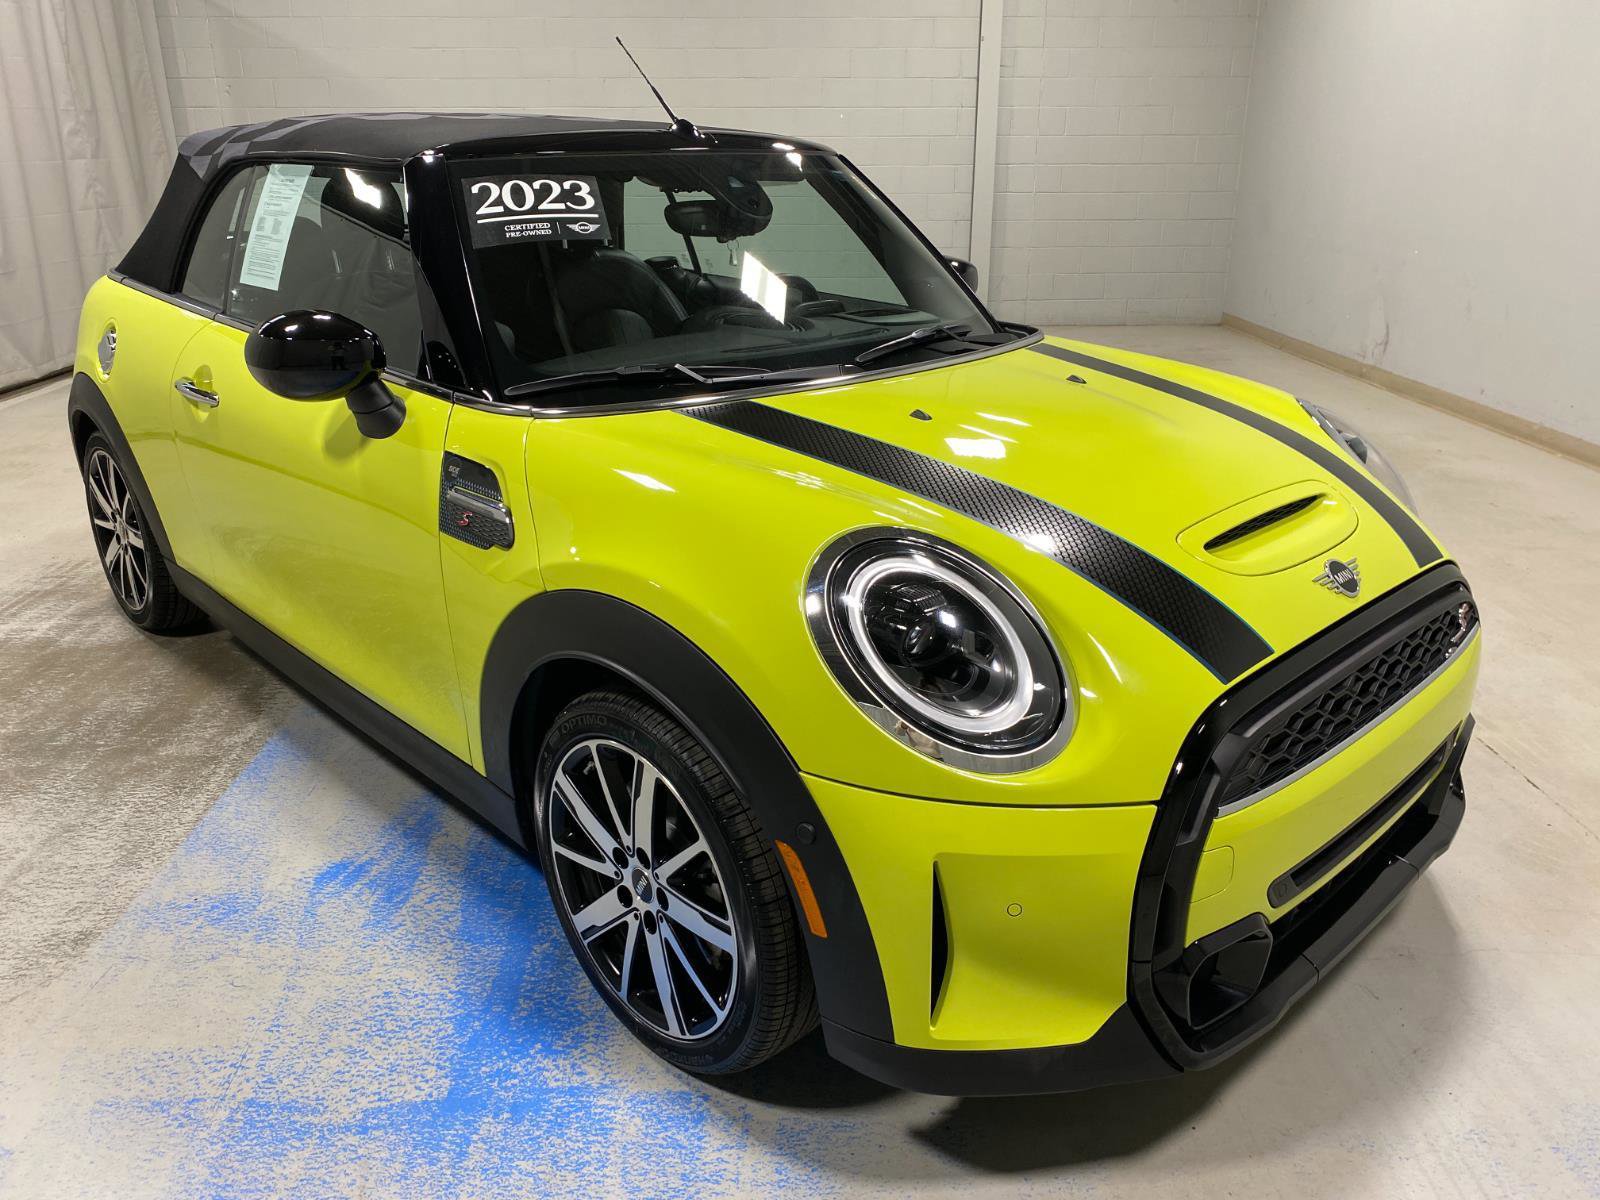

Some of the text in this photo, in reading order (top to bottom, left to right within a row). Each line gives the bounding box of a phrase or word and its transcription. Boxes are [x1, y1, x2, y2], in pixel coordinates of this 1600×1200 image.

[471, 180, 595, 214] 2023
[504, 222, 551, 232] CERTIFIED
[505, 229, 552, 238] PRE-OWNED
[1333, 568, 1354, 585] MINI
[561, 714, 607, 734] OPTIMO
